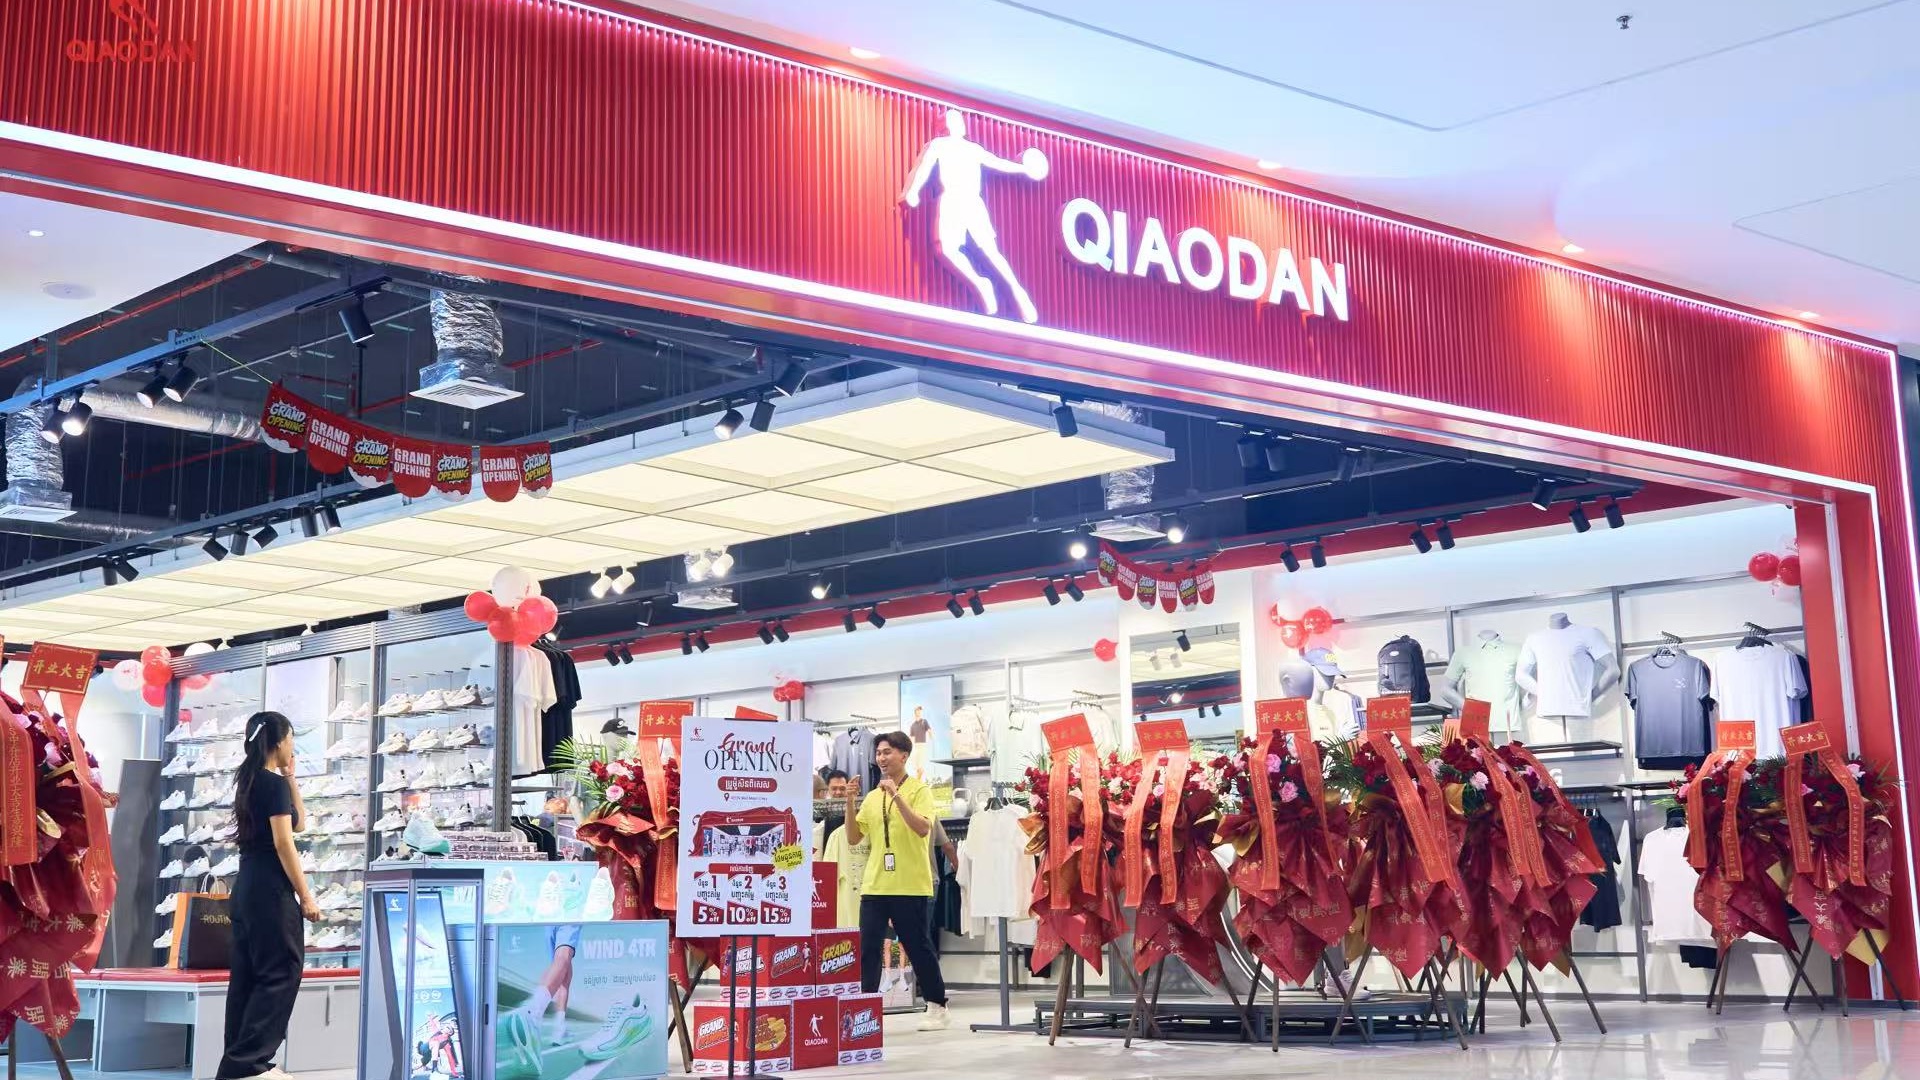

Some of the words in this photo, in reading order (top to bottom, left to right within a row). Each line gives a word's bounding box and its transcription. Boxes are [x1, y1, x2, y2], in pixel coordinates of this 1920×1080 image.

[1061, 197, 1349, 322] QIAODAN
[270, 402, 306, 422] GRAND
[267, 415, 305, 433] OPENING
[311, 419, 350, 446] GRAND
[309, 432, 348, 457] OPENING
[355, 441, 388, 455] GRAND
[353, 453, 388, 466] OPENING
[394, 448, 431, 467] GRAND
[437, 456, 468, 471] GRAND
[482, 457, 516, 471] GRAND
[523, 453, 549, 472] GRAND
[394, 461, 431, 479] OPENING
[437, 468, 469, 482] OPENING
[483, 470, 519, 482] OPENING
[525, 463, 550, 482] OPENING
[1159, 581, 1177, 590] GRAND
[33, 659, 88, 680] 开业大吉
[644, 714, 681, 727] 开业大
[1261, 709, 1305, 724] 开业大吉
[717, 732, 776, 759] Grand
[1787, 730, 1825, 747] 开业大吉
[704, 748, 793, 772] OPENING
[711, 875, 717, 888] 1
[744, 875, 753, 889] 2
[778, 876, 787, 890] 3
[582, 939, 625, 959] WIND
[773, 944, 798, 964] GRAND
[822, 940, 851, 960] GRAND
[854, 1009, 871, 1026] NEW
[699, 1017, 724, 1037] GRAND
[804, 1038, 828, 1047] QIAODAN
